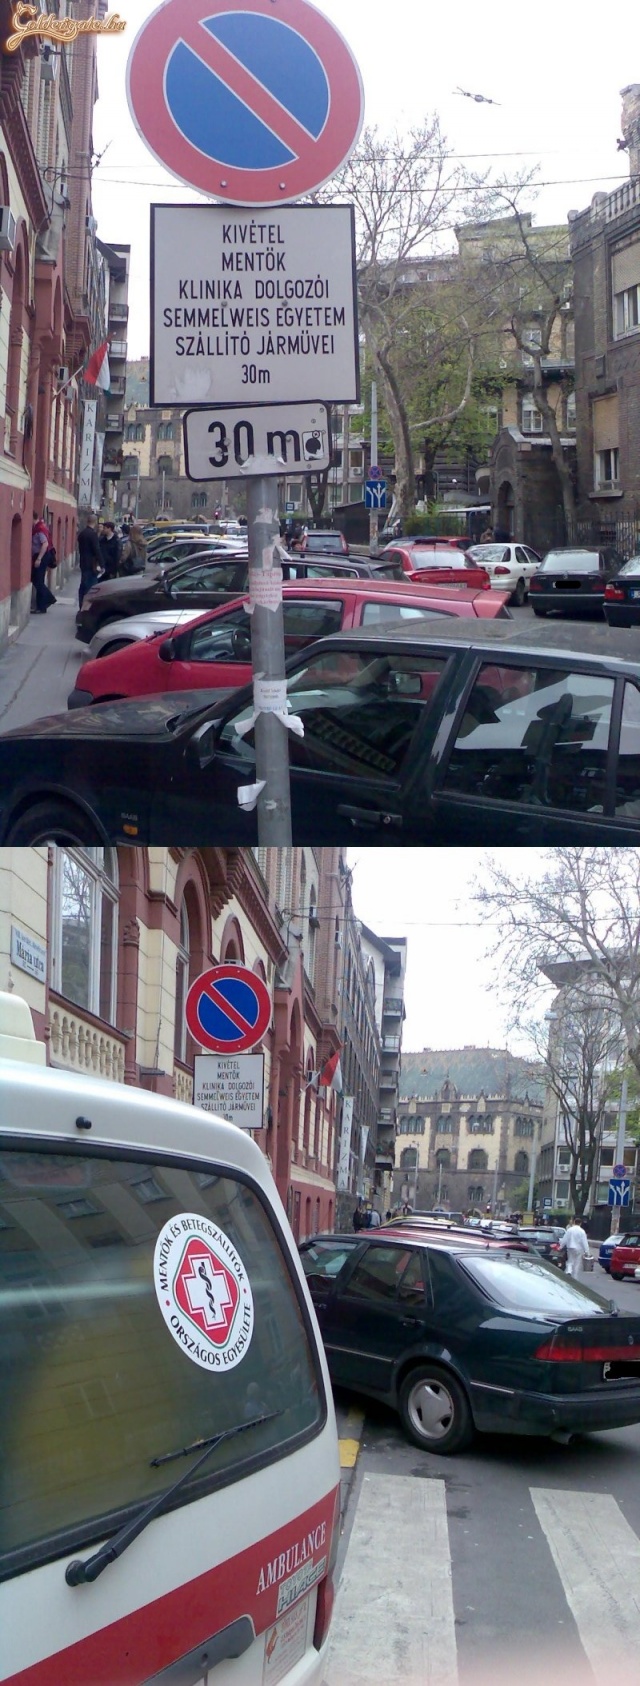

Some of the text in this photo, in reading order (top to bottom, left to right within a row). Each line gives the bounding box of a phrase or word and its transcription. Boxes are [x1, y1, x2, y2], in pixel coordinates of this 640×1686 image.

[222, 219, 285, 244] KIVÉTEL
[178, 274, 329, 299] KLINIKA DOLGOZÓI
[163, 306, 346, 328] SEMMELWEIS EGYETEM
[175, 330, 250, 356] SZÁLLÍTÓ
[241, 364, 270, 384] 30m
[81, 403, 95, 502] KARIZMA
[207, 420, 301, 468] 30 m
[217, 1059, 240, 1070] KIVÉTEL
[196, 1092, 260, 1101] SEMMELWEIS EGYETEM
[202, 1079, 255, 1090] KLINIKA DOLGOZÓI
[340, 1100, 352, 1189] KARIZMA
[169, 1223, 182, 1239] ÉS
[170, 1314, 221, 1366] ORSZÁGOS
[255, 1521, 327, 1596] AMBULANCE
[277, 1557, 326, 1614] HIACE
